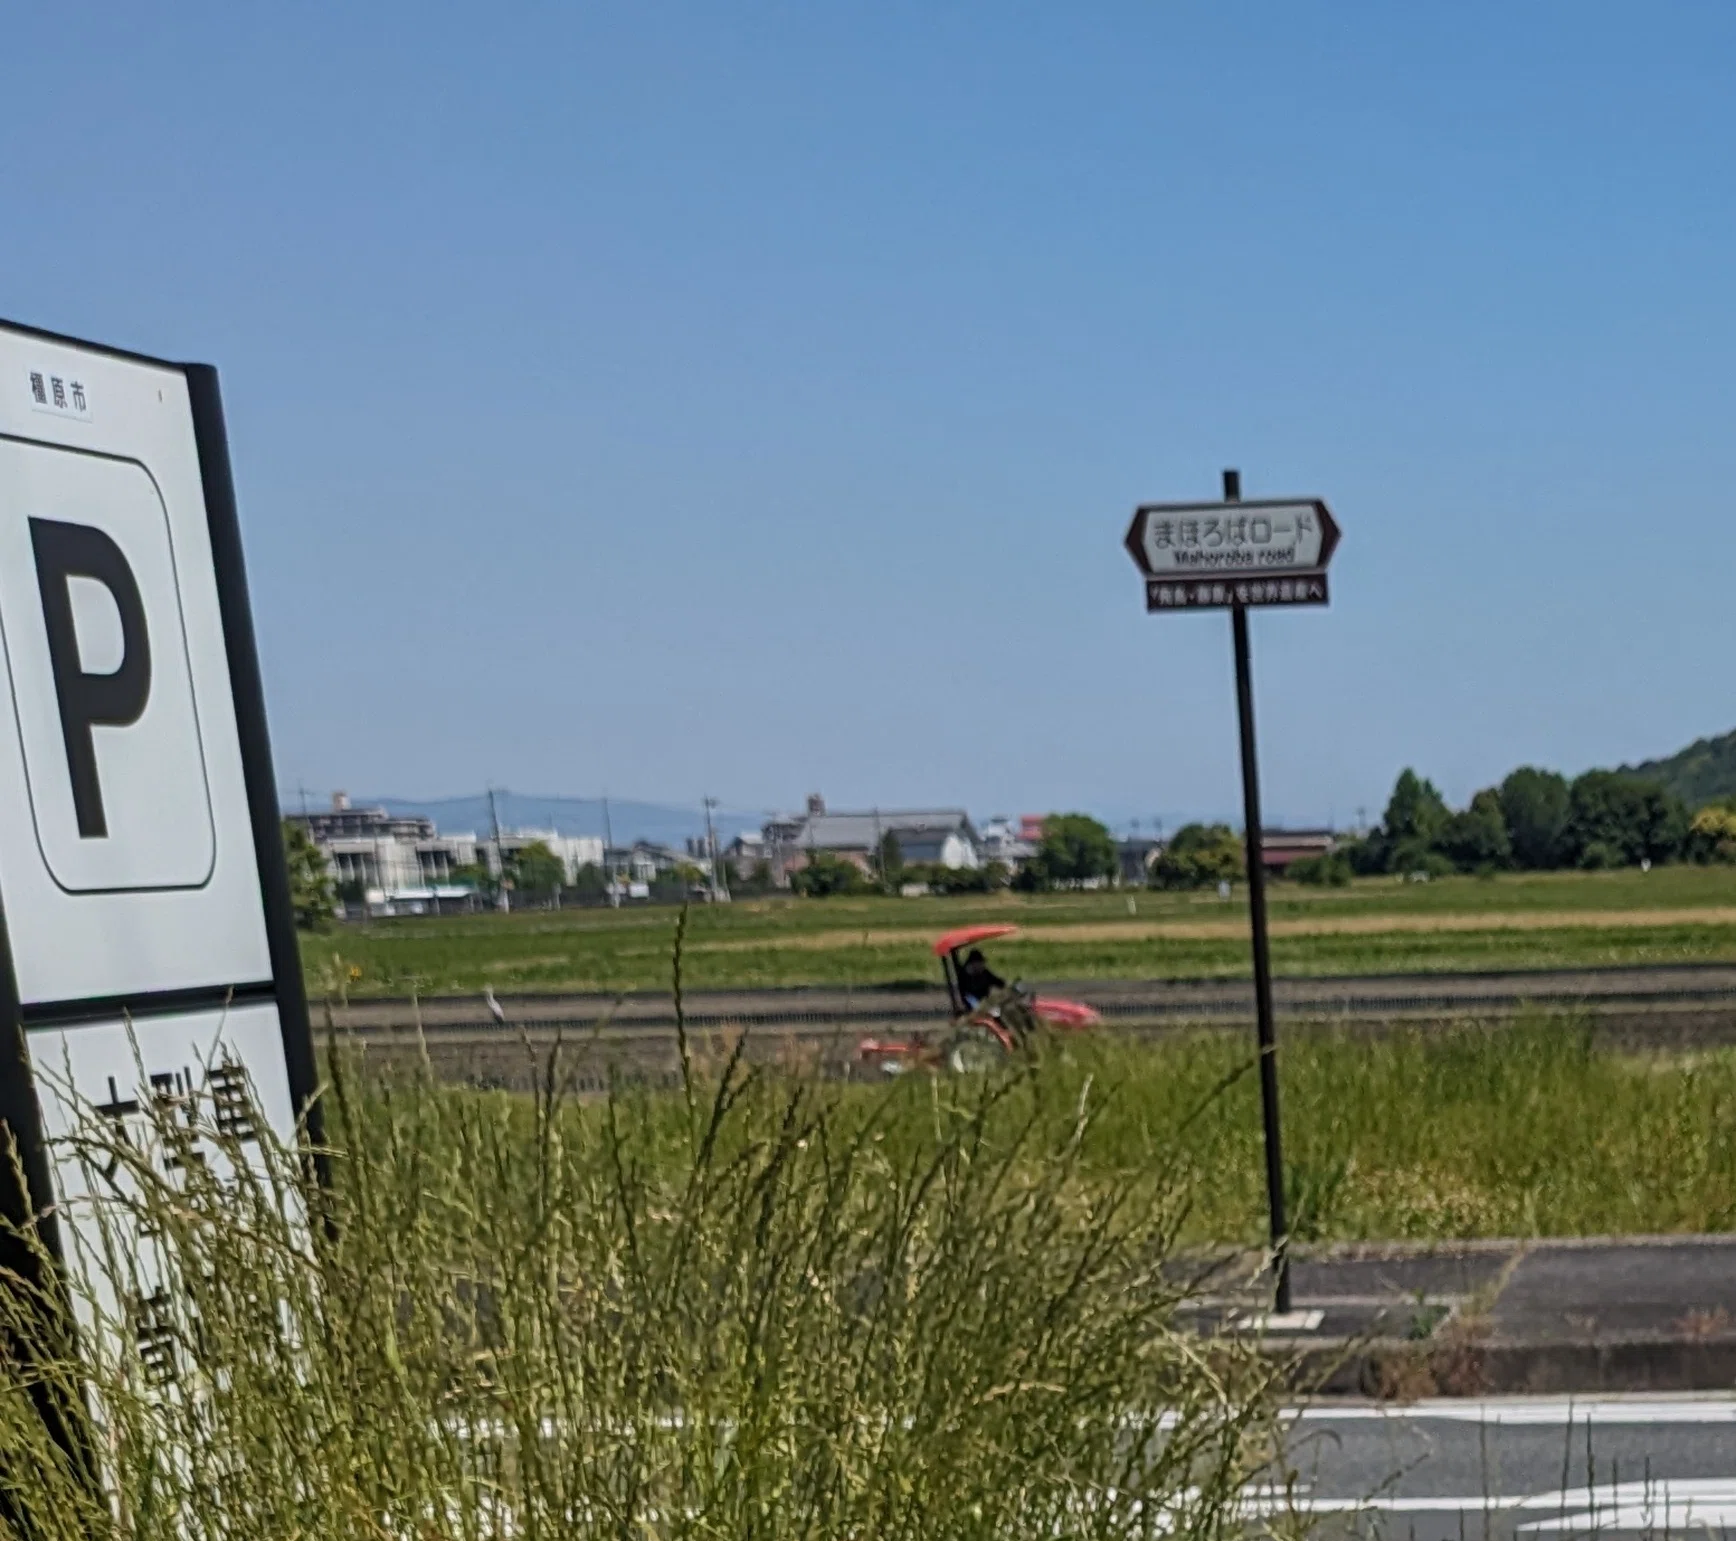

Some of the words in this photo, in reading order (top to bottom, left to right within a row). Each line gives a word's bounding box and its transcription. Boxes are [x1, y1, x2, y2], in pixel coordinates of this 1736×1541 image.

[1153, 513, 1314, 549] まほろばロード
[28, 515, 151, 839] P
